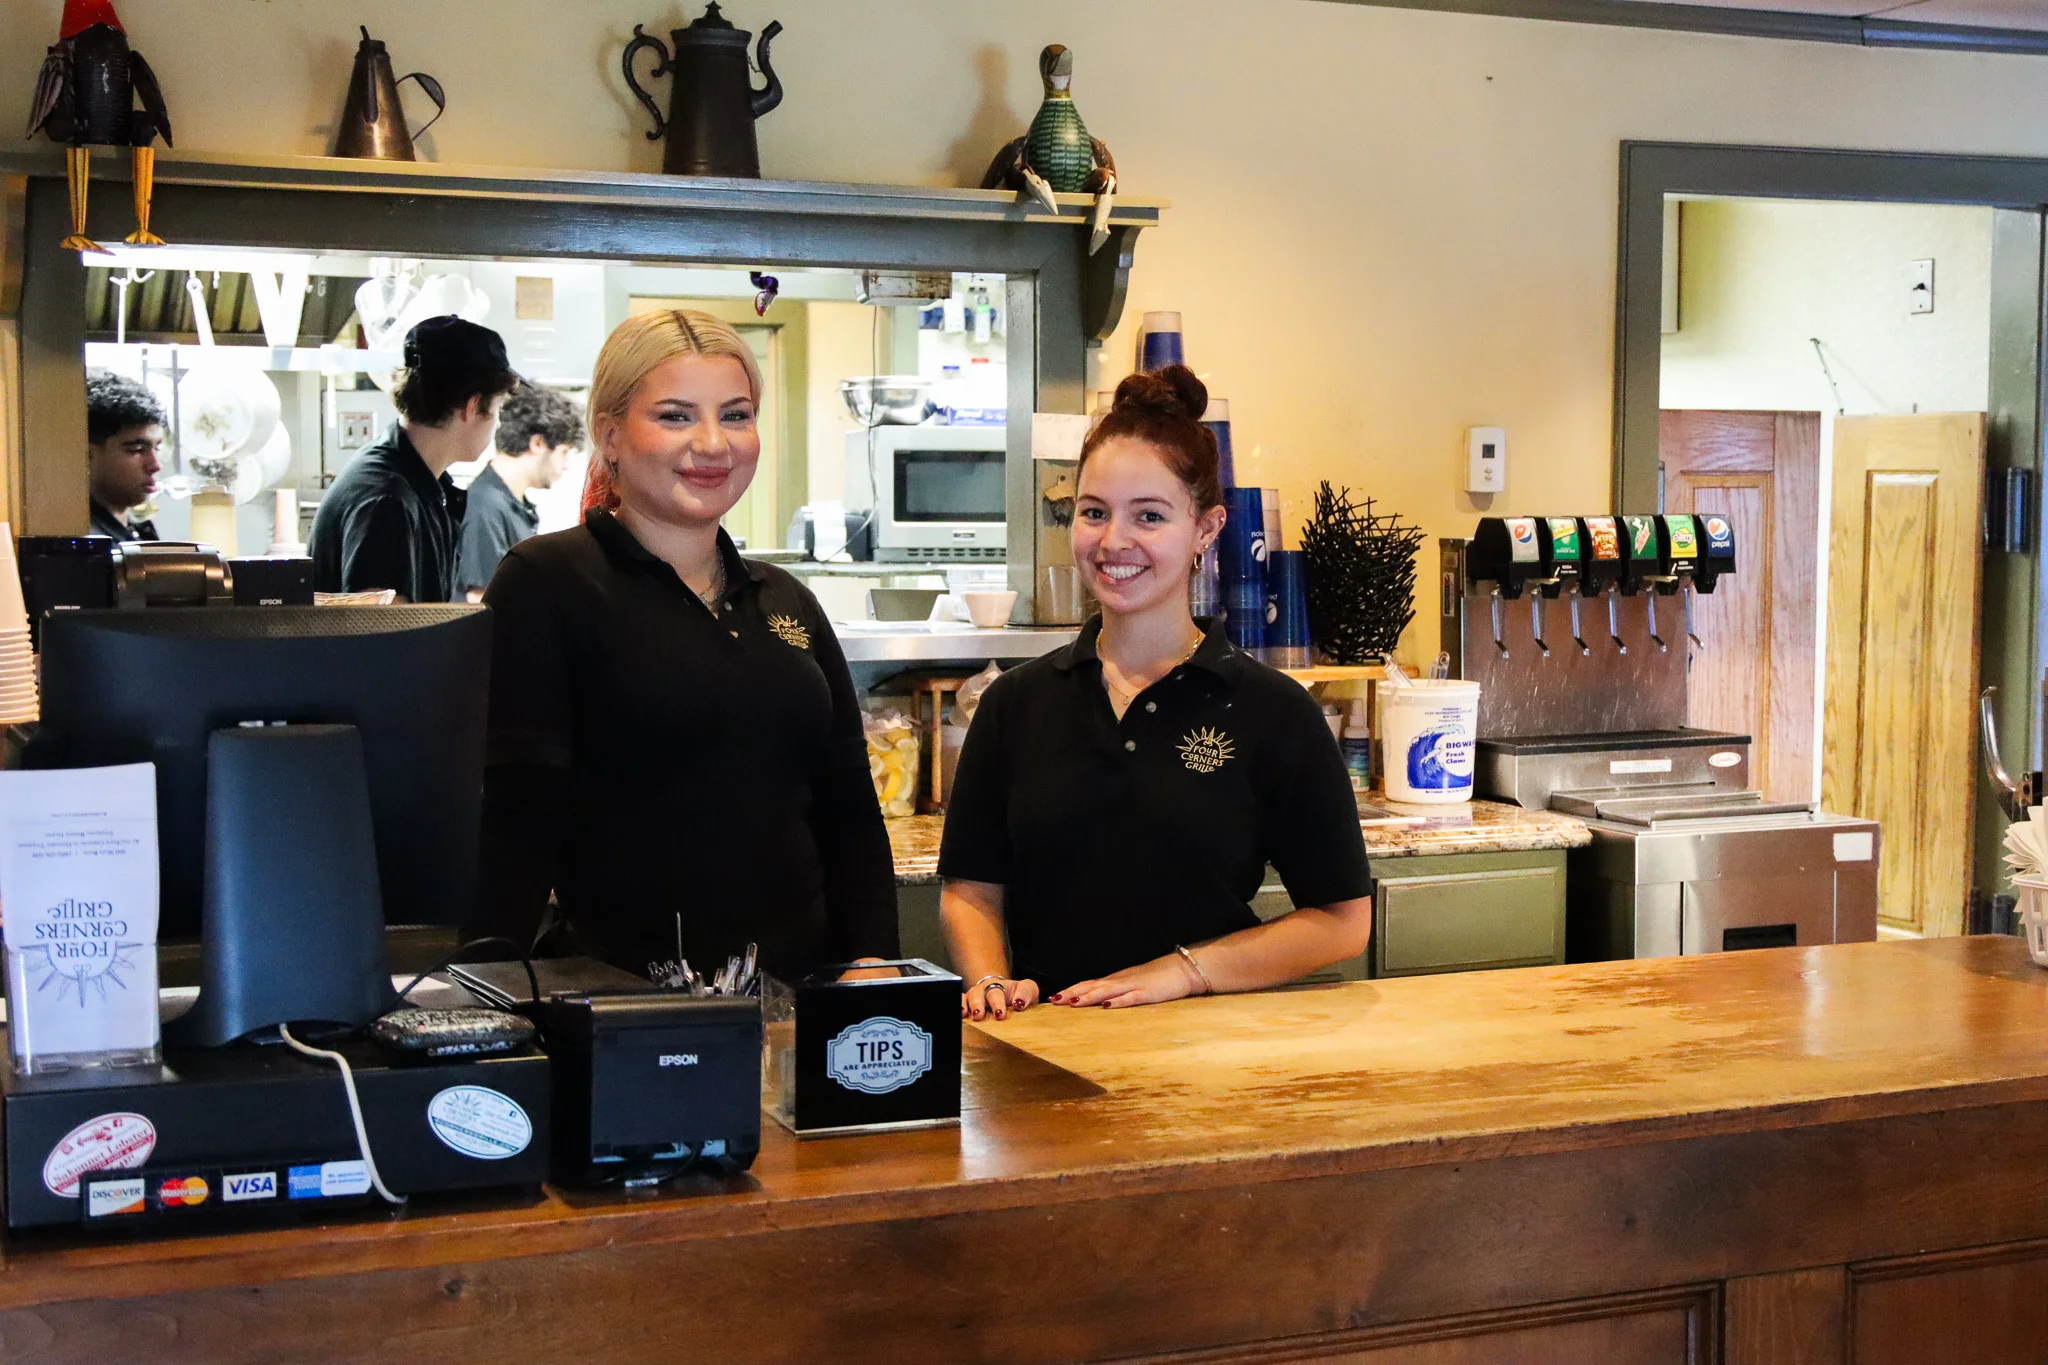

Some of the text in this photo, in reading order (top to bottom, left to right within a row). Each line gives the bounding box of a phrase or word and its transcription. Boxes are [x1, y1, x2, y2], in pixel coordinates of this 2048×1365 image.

[1711, 540, 1730, 549] pepsi
[1181, 752, 1225, 767] CORNERS
[35, 920, 128, 939] CORNERS
[57, 941, 109, 959] FOUR
[856, 1040, 904, 1063] TIPS
[659, 1054, 699, 1067] EPSON
[862, 1060, 918, 1070] APPRECIATED
[107, 1128, 149, 1154] Lobster
[92, 1187, 141, 1200] DISCOVER
[228, 1176, 274, 1195] VISA
